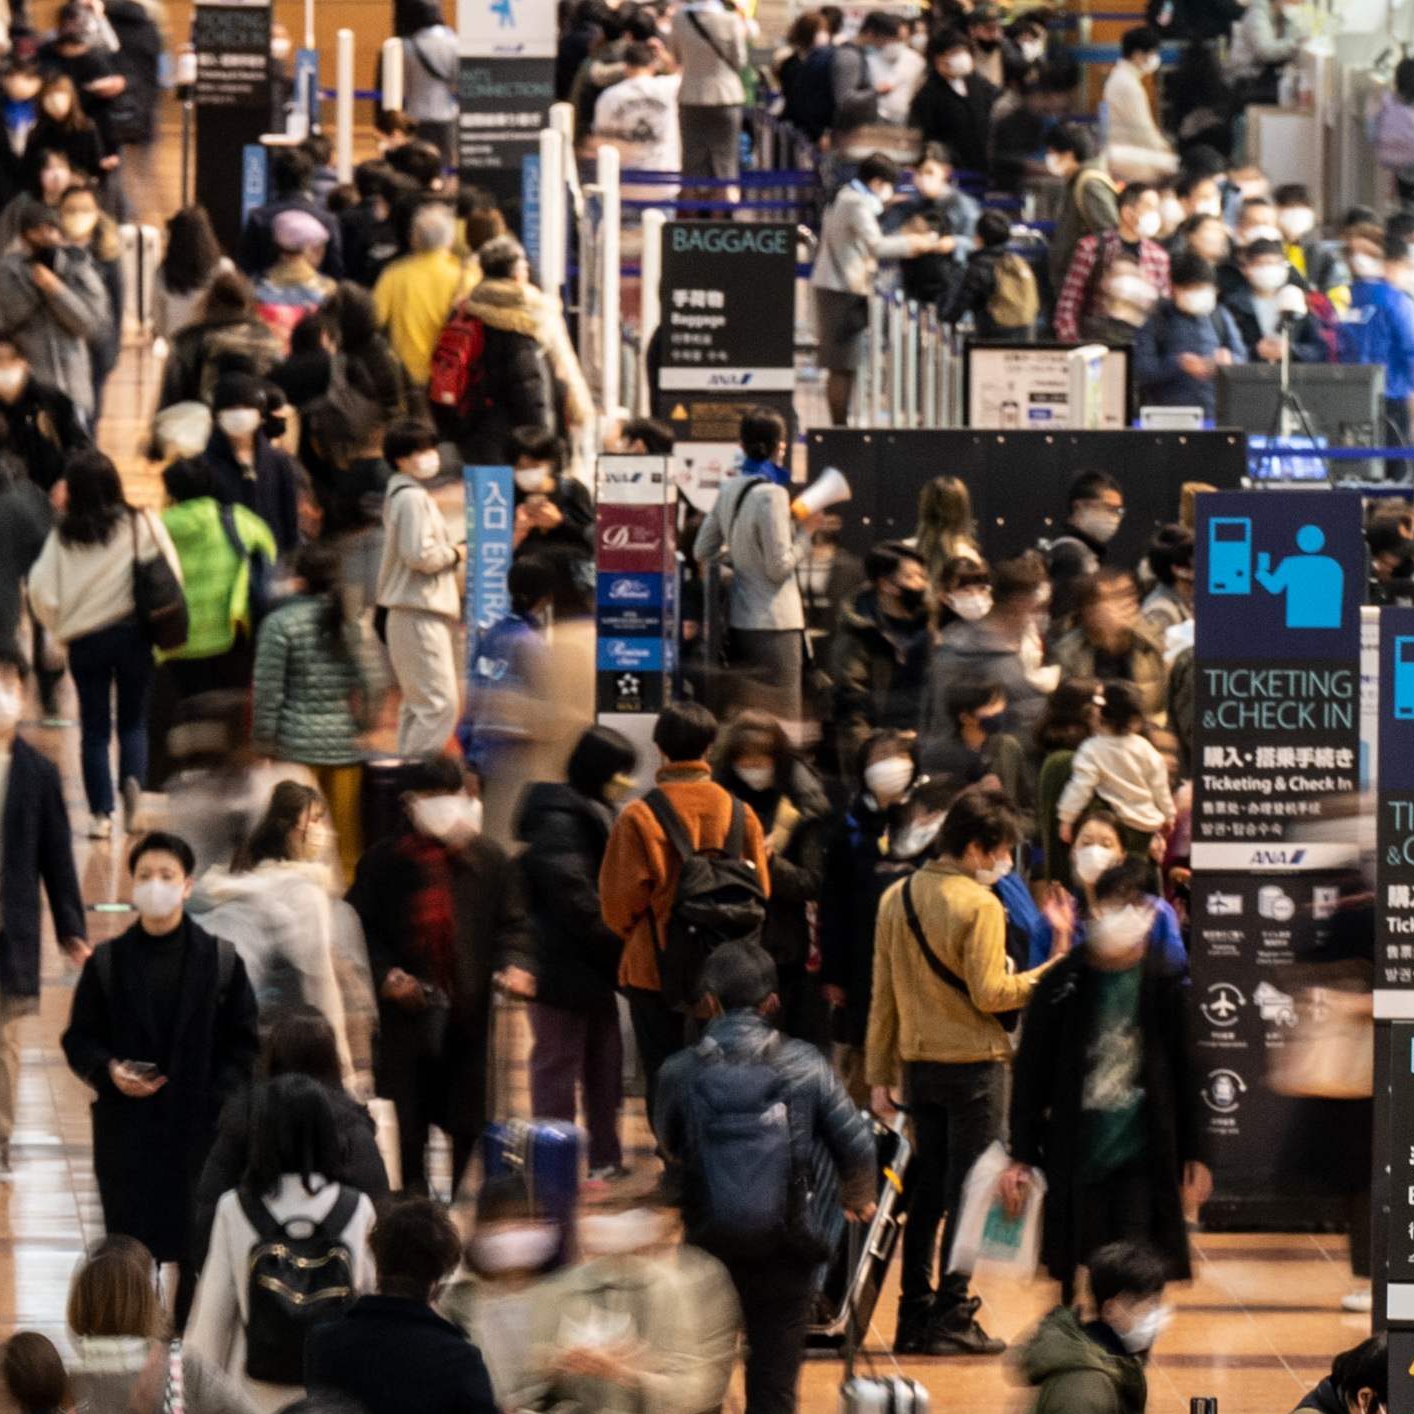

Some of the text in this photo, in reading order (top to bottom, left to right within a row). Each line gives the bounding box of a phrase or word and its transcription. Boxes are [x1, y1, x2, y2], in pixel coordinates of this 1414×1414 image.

[672, 227, 788, 253] BAGGAGE
[483, 480, 508, 530] 入口
[1203, 669, 1353, 698] TICKETING
[1324, 702, 1353, 729] IN
[1202, 776, 1353, 795] Ticketing & Check In
[1251, 851, 1288, 864] ANA
